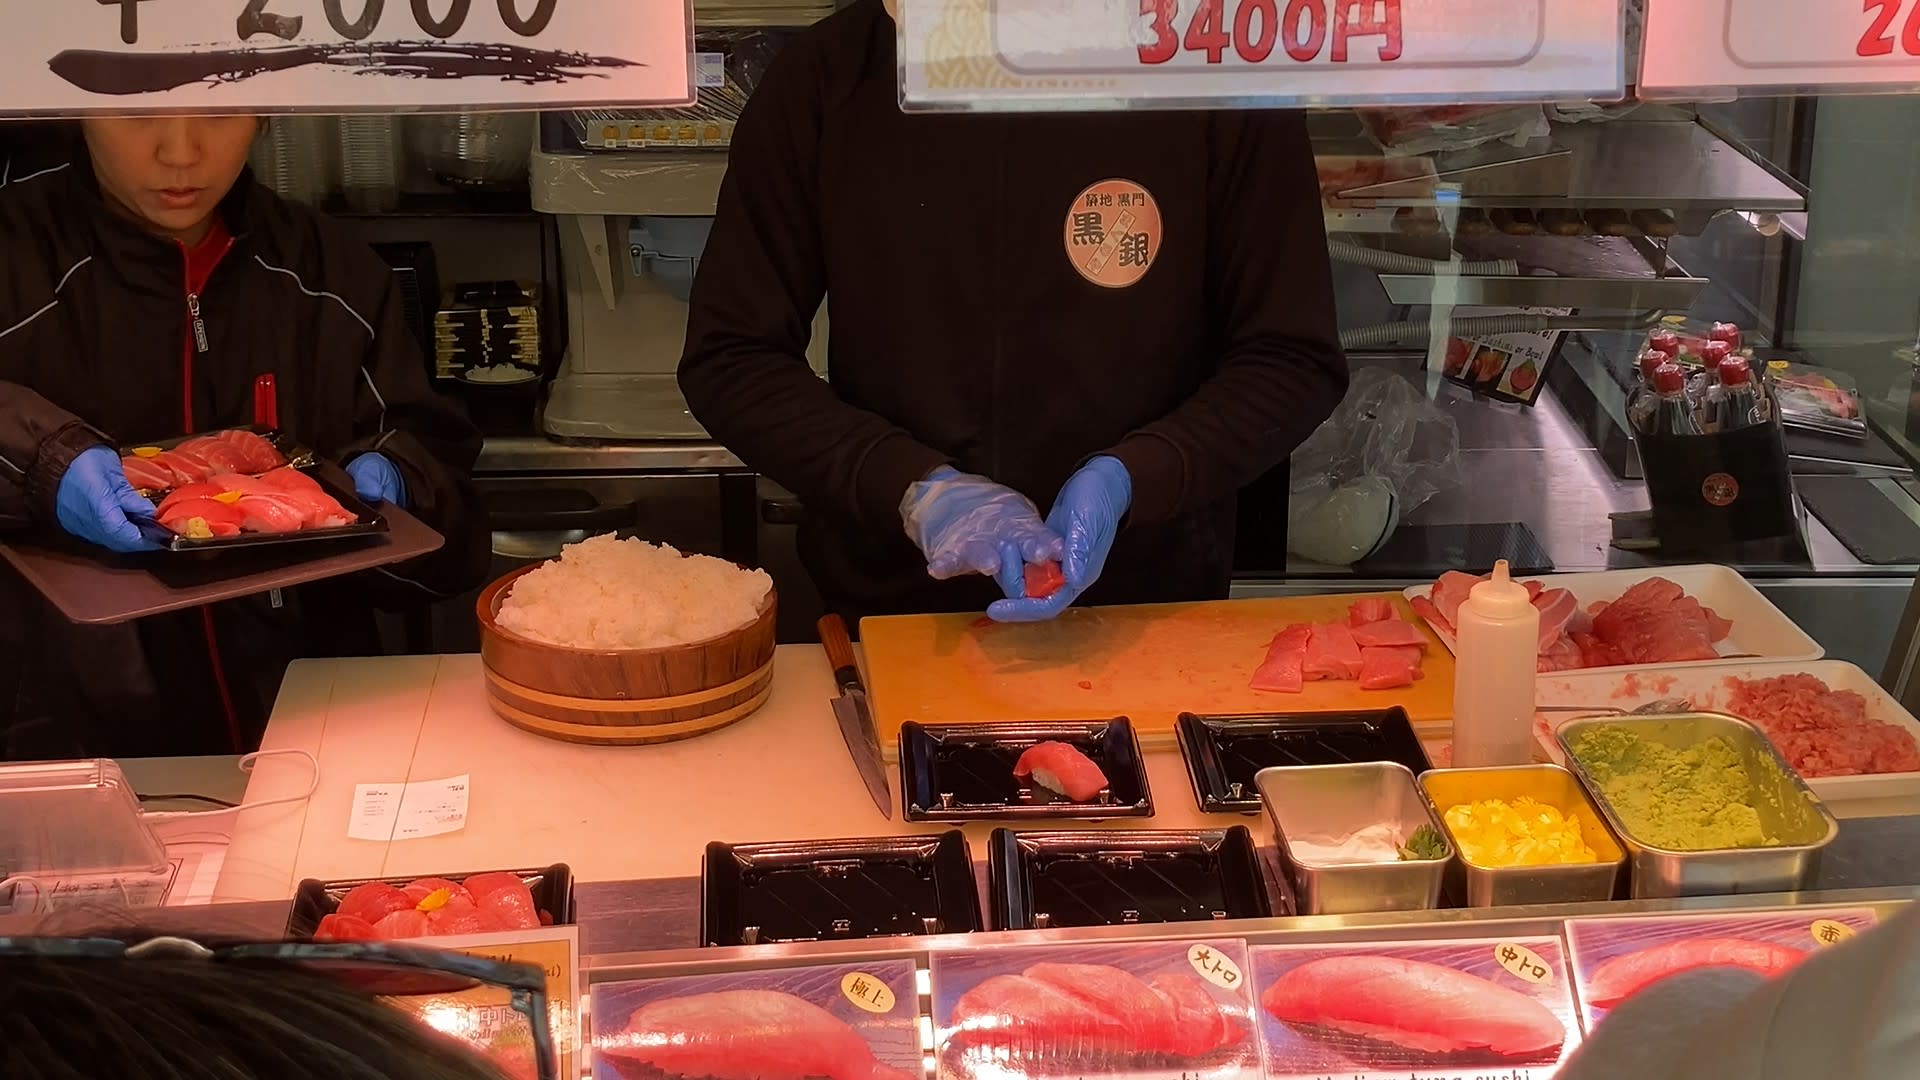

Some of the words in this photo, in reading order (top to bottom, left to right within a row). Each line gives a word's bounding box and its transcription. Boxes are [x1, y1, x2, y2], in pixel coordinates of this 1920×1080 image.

[1138, 0, 1404, 64] 3400円
[1193, 949, 1238, 984] 大トロ
[1501, 946, 1547, 979] 中トロ
[849, 976, 885, 1008] 極上
